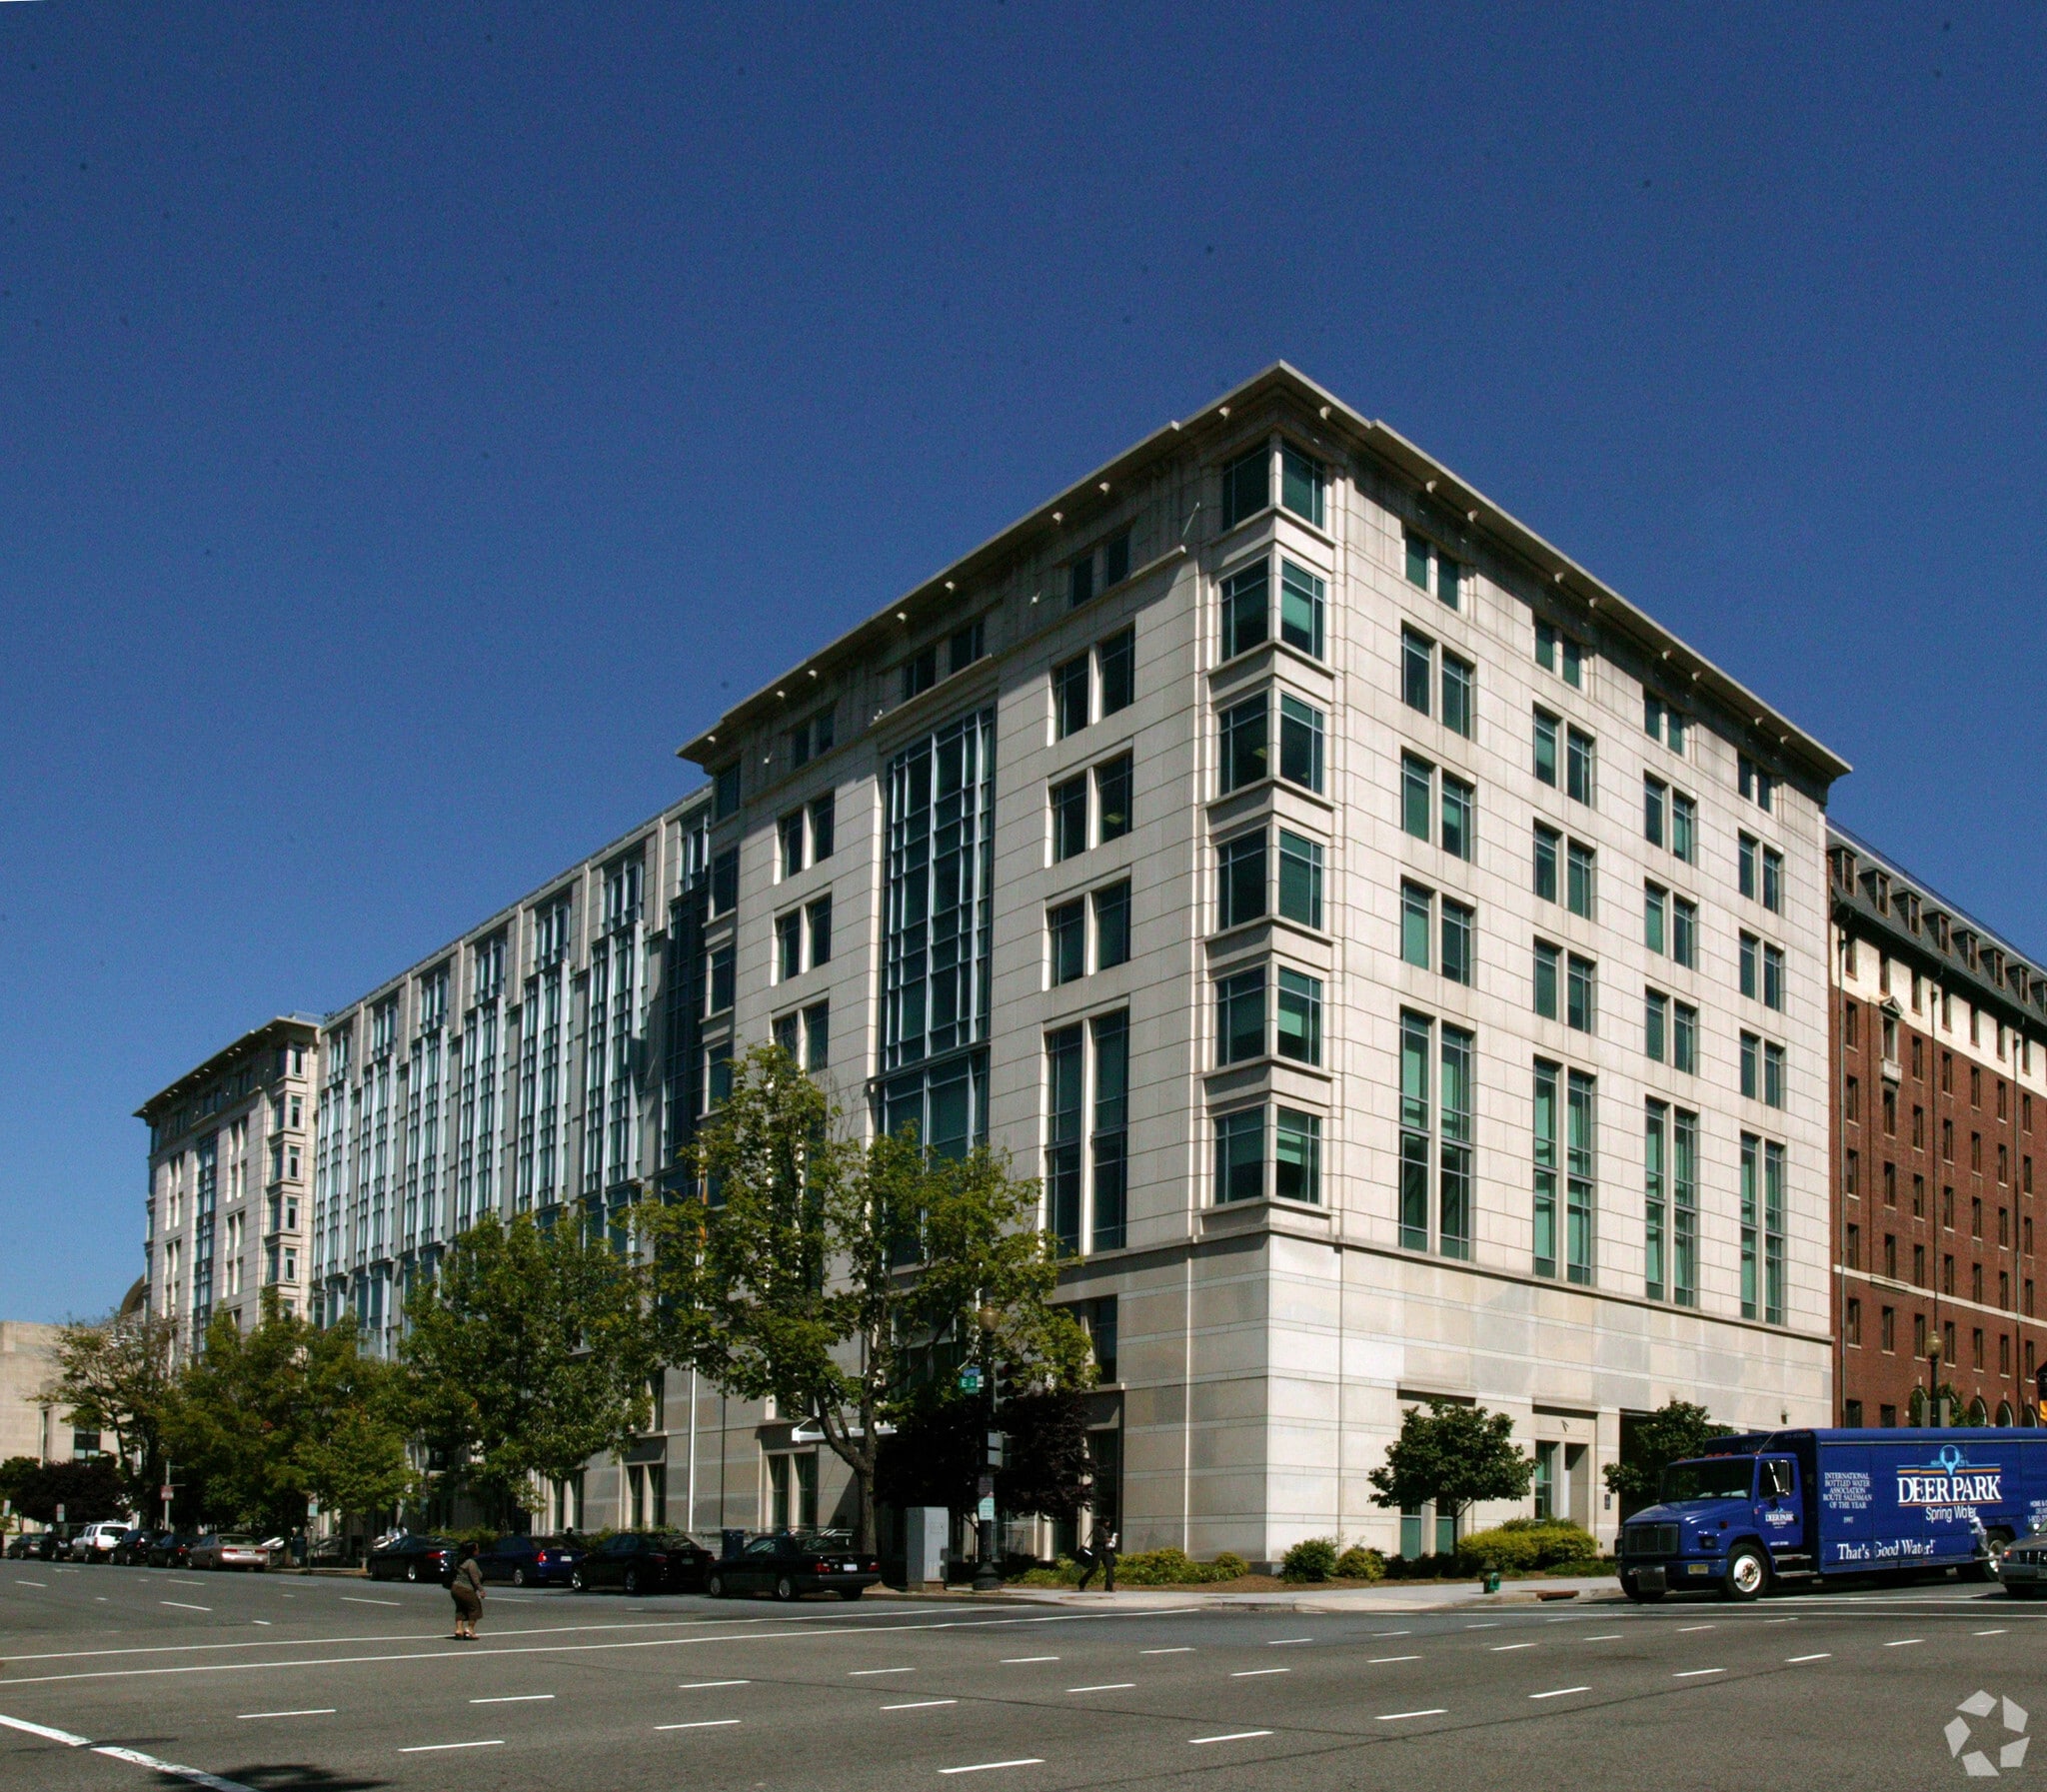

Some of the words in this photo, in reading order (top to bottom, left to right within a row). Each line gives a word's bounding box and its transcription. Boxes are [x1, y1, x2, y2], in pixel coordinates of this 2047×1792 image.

[1897, 1476, 1951, 1503] DEER
[1951, 1475, 2002, 1501] PARK
[1765, 1513, 1779, 1522] DEER
[1925, 1506, 1952, 1524] Spring
[1954, 1504, 1977, 1519] Water
[1837, 1543, 1870, 1560] That's
[1875, 1540, 1899, 1558] Good
